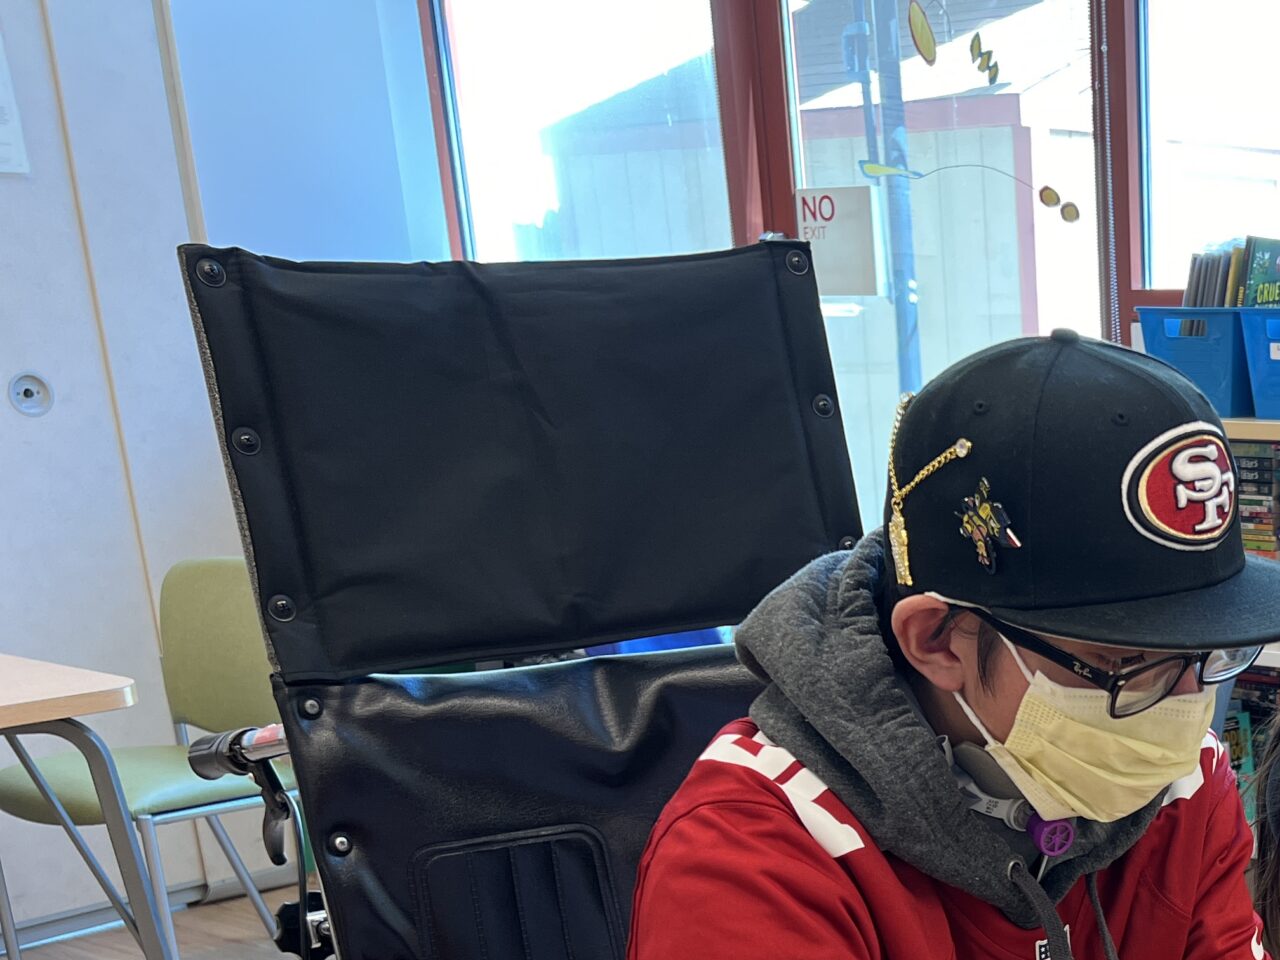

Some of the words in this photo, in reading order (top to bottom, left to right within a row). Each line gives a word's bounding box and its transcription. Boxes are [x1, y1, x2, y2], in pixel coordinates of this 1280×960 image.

[802, 195, 835, 222] NO
[803, 226, 827, 240] EXIT
[1171, 443, 1235, 532] SF
